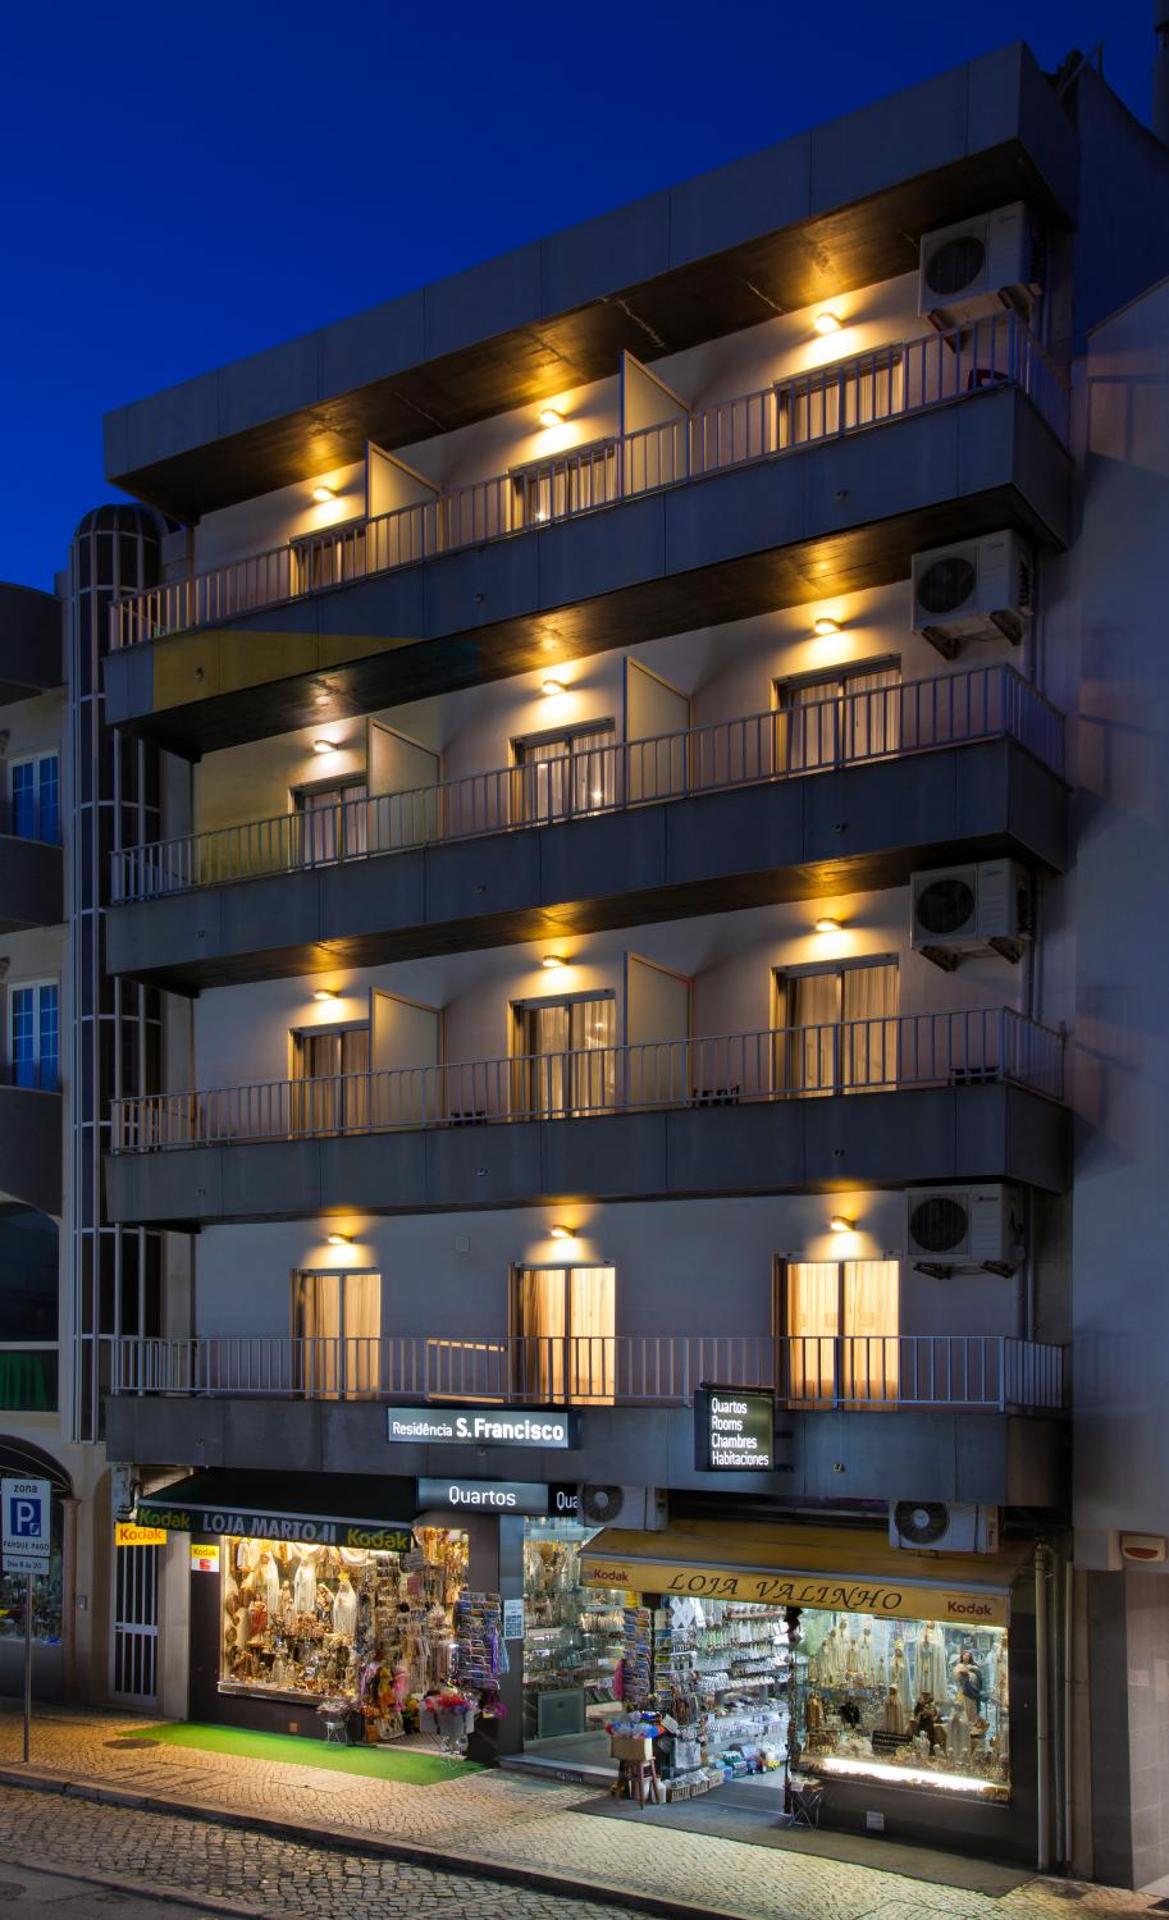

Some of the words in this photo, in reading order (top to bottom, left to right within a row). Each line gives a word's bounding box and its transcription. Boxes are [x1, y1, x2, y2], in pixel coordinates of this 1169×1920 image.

[711, 1397, 748, 1414] Quartos
[392, 1421, 453, 1437] Residência
[474, 1418, 564, 1441] Francisco
[711, 1415, 743, 1431] Rooms
[711, 1433, 758, 1449] Chambres
[711, 1451, 769, 1466] Habitaciones
[13, 1484, 38, 1493] zona
[449, 1485, 517, 1506] Quartos
[556, 1491, 579, 1511] Qua
[139, 1508, 190, 1529] Kodak
[120, 1528, 163, 1541] Kodak
[202, 1513, 246, 1534] LOJA
[250, 1517, 317, 1542] MARTO
[346, 1527, 409, 1549] Kodak
[592, 1568, 629, 1582] Kodak
[667, 1573, 740, 1596] LOJA
[755, 1578, 903, 1611] VALINHO
[946, 1600, 993, 1616] Kodak
